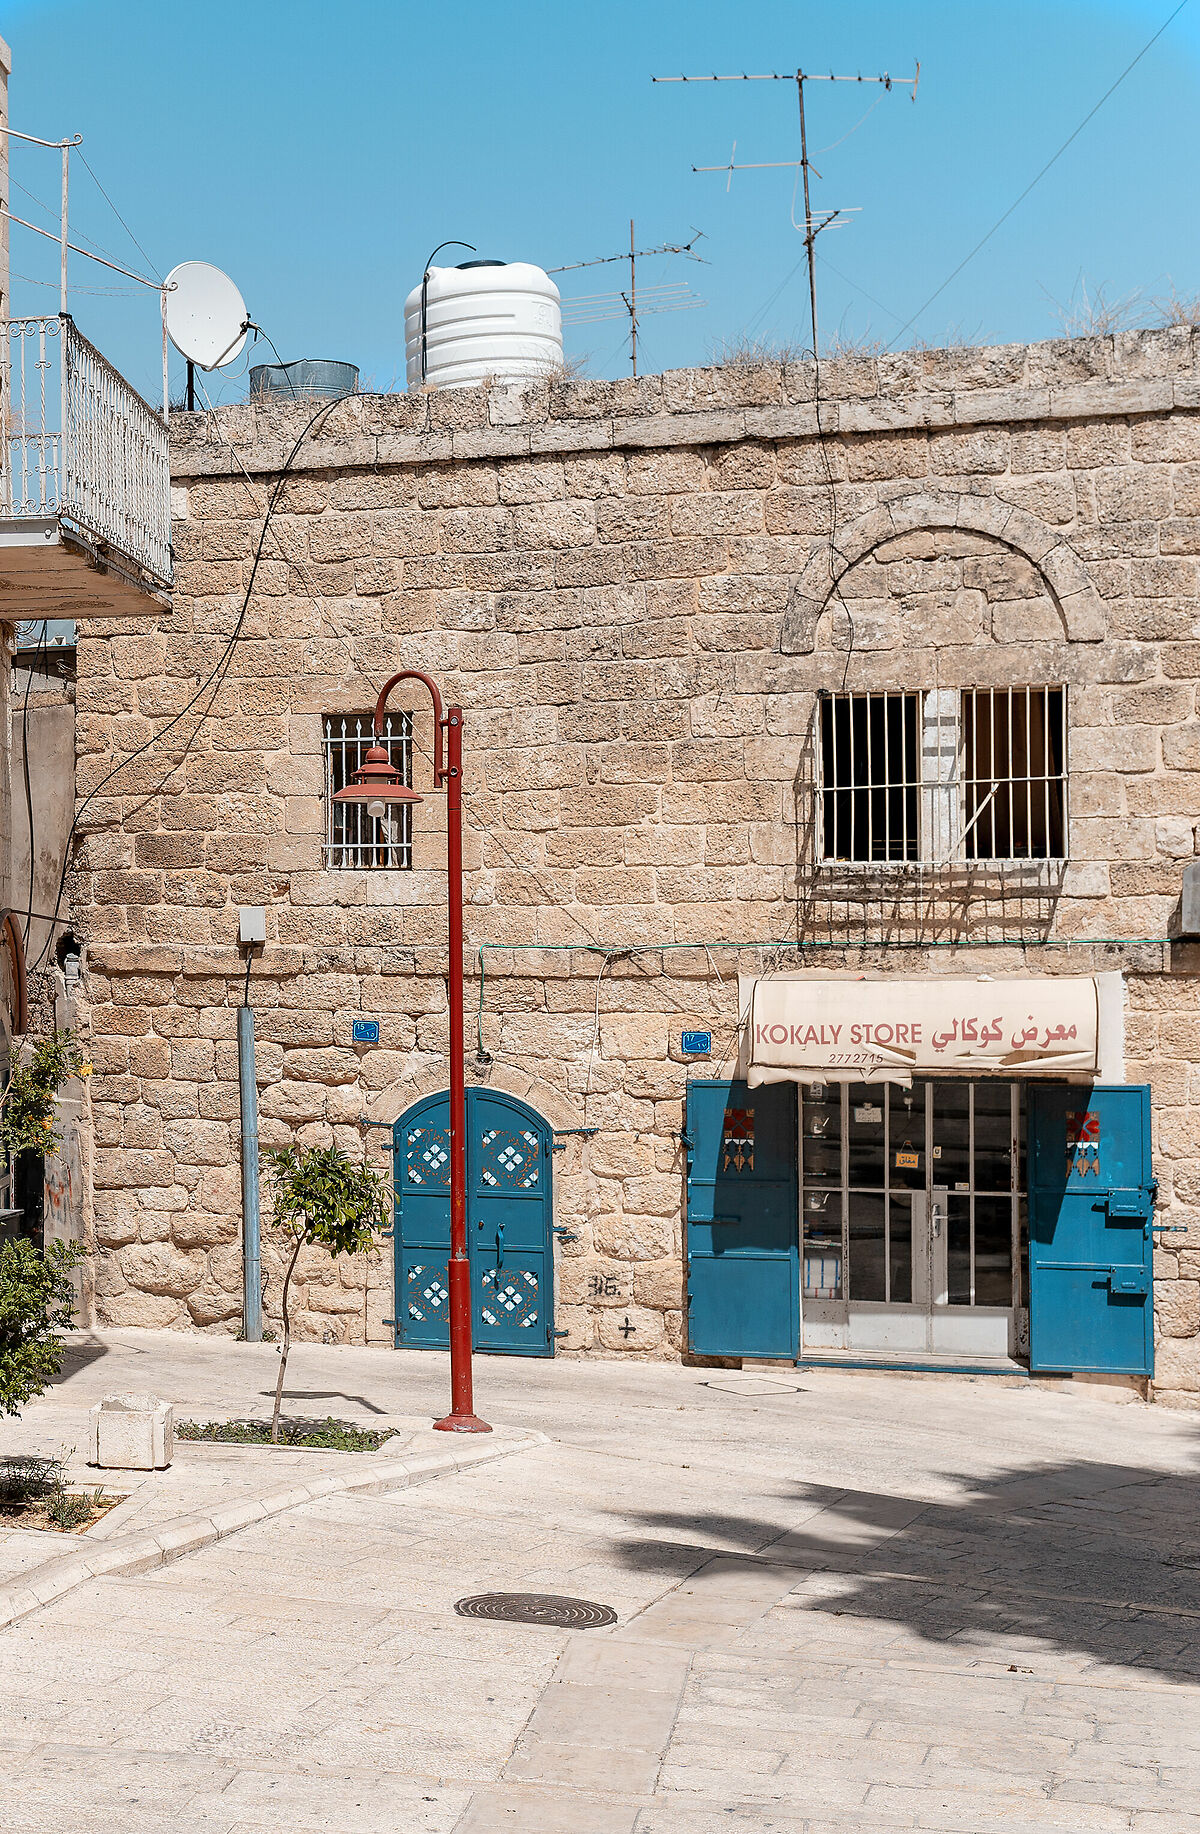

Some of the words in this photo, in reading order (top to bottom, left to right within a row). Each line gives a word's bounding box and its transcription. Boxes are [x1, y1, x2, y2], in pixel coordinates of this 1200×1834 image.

[357, 1023, 365, 1031] 15
[756, 1023, 843, 1045] KOKALY
[850, 1023, 922, 1045] STORE
[931, 1016, 1003, 1053] كوكالي
[1011, 1014, 1078, 1049] معرض
[686, 1034, 695, 1042] 17
[828, 1053, 884, 1064] 2772715
